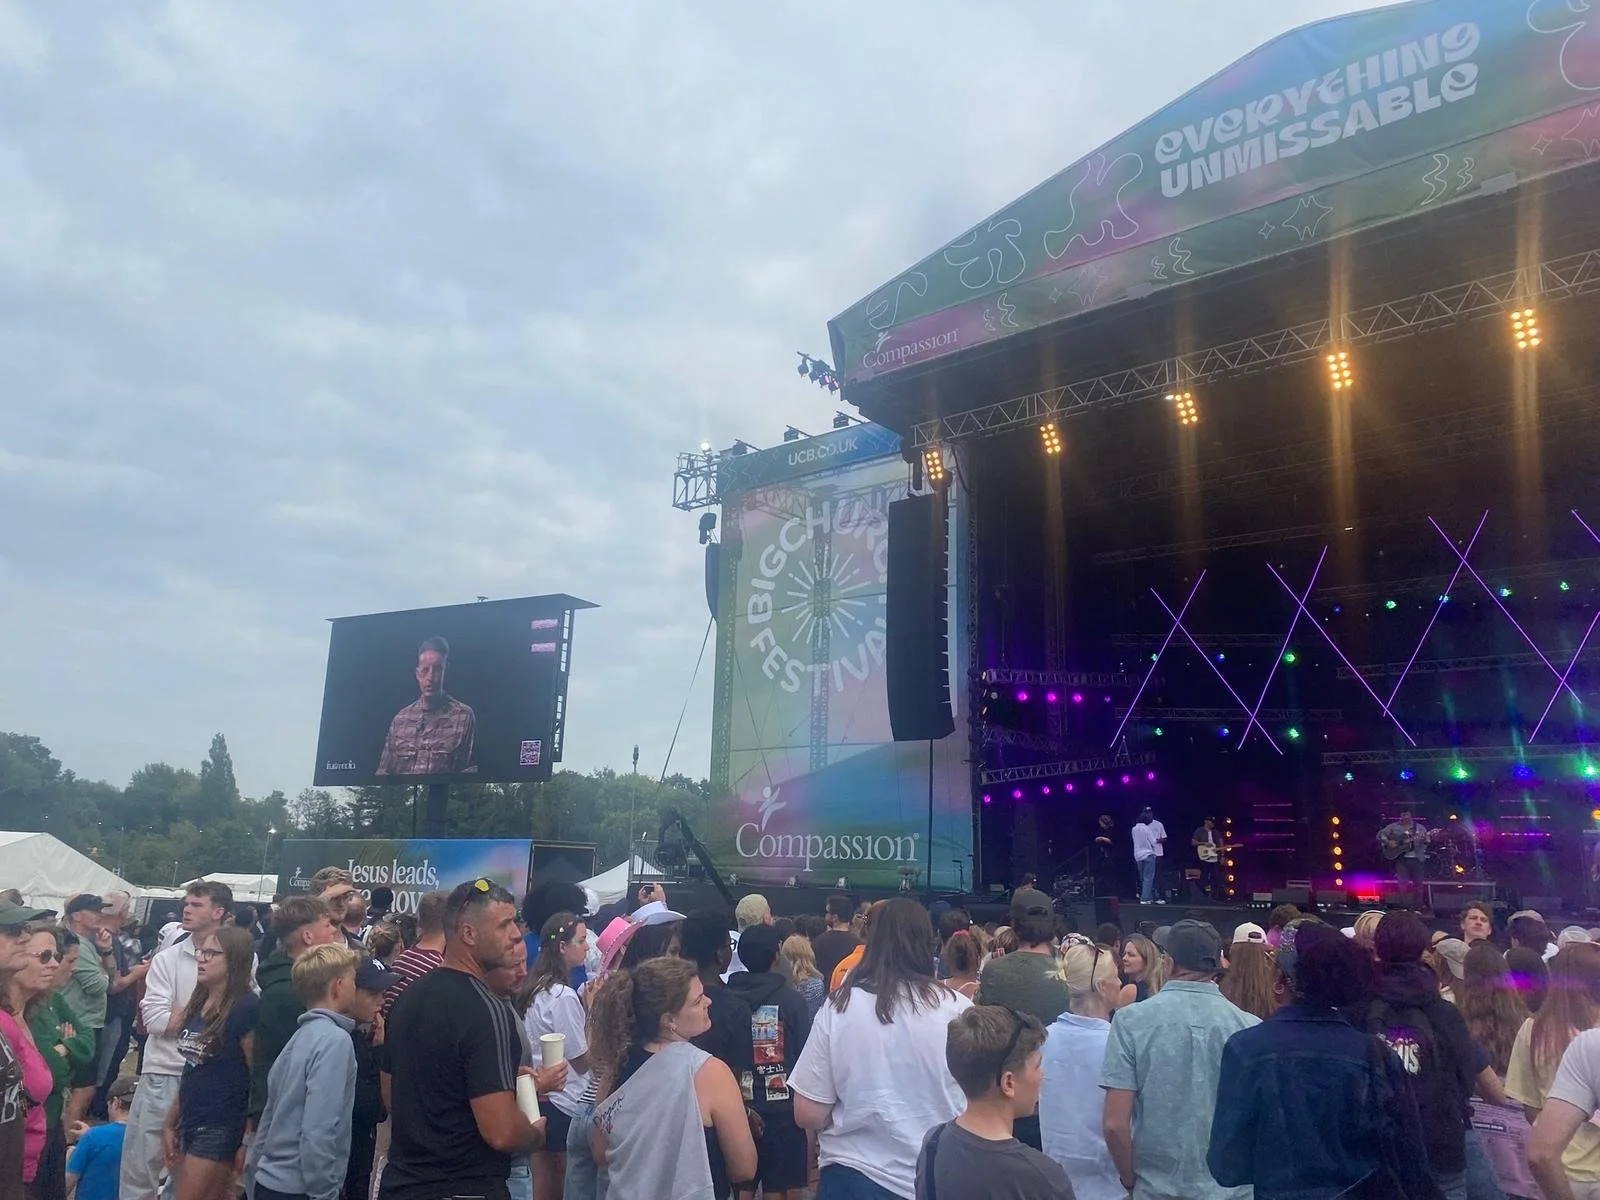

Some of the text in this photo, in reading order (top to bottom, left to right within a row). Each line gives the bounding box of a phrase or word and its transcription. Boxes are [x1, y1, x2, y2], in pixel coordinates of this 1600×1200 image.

[1160, 63, 1480, 198] UNMISSABLE
[788, 437, 858, 466] UCB.CO.UK
[747, 544, 788, 625] BIG
[348, 859, 440, 890] Jesus leads,
